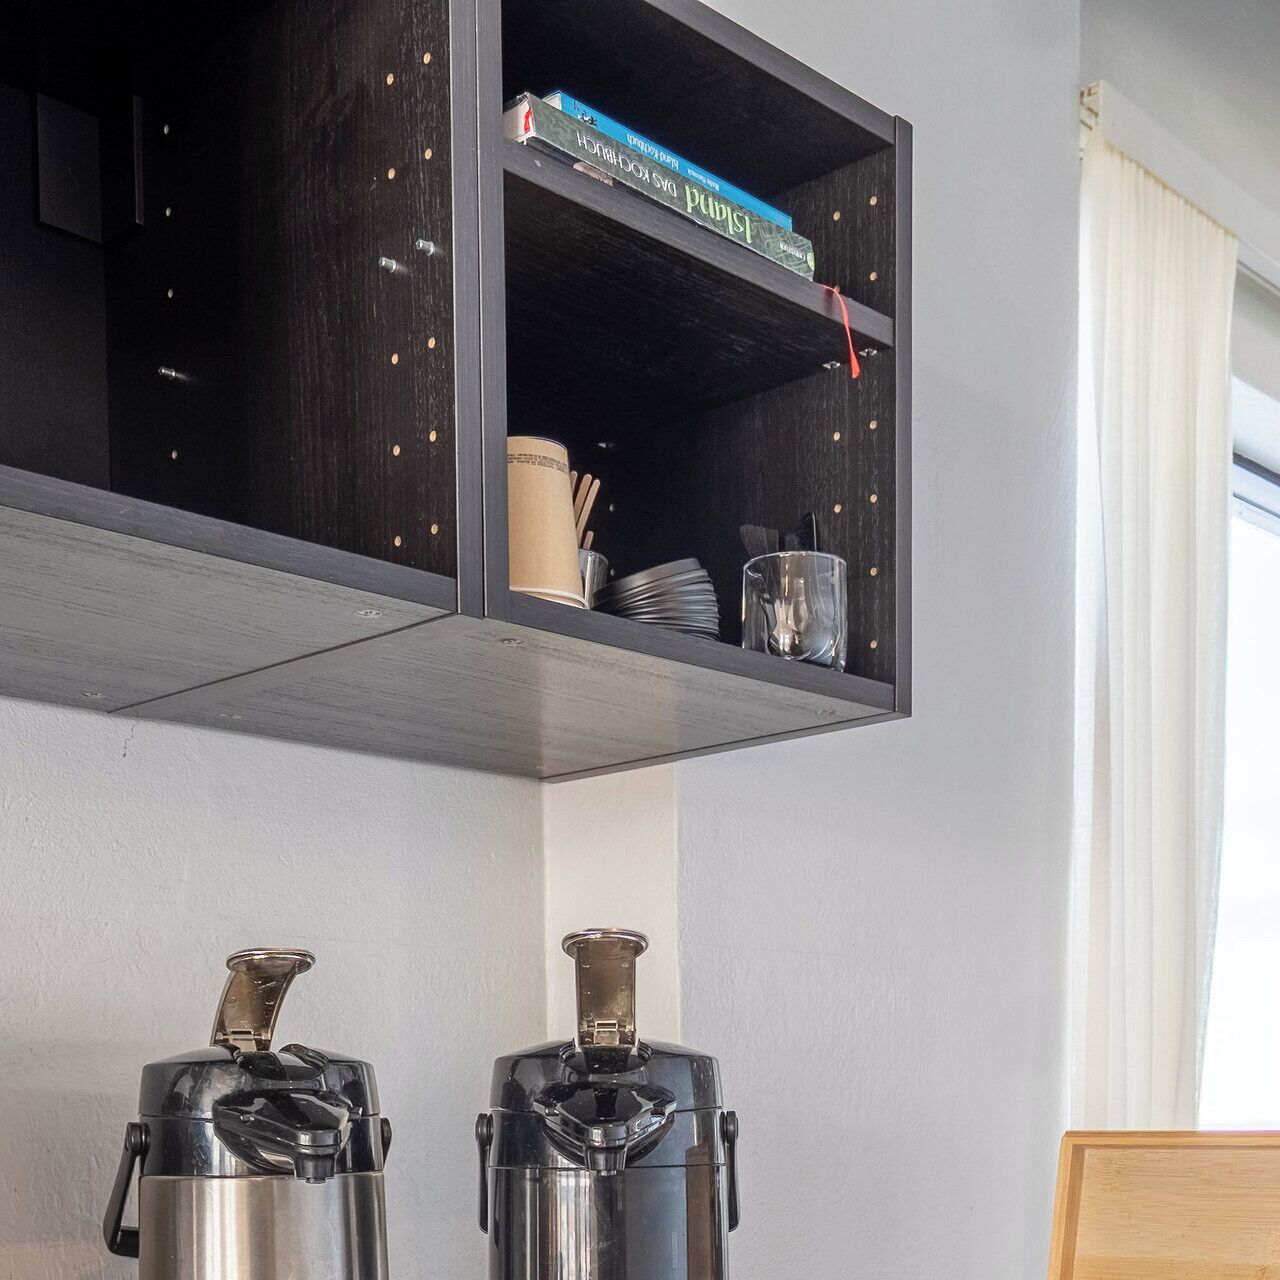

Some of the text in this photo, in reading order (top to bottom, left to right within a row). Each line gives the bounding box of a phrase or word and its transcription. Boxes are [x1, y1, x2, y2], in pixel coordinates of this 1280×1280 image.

[576, 131, 650, 183] KOCHBUCH
[653, 172, 677, 197] DAS
[685, 183, 752, 244] Island
